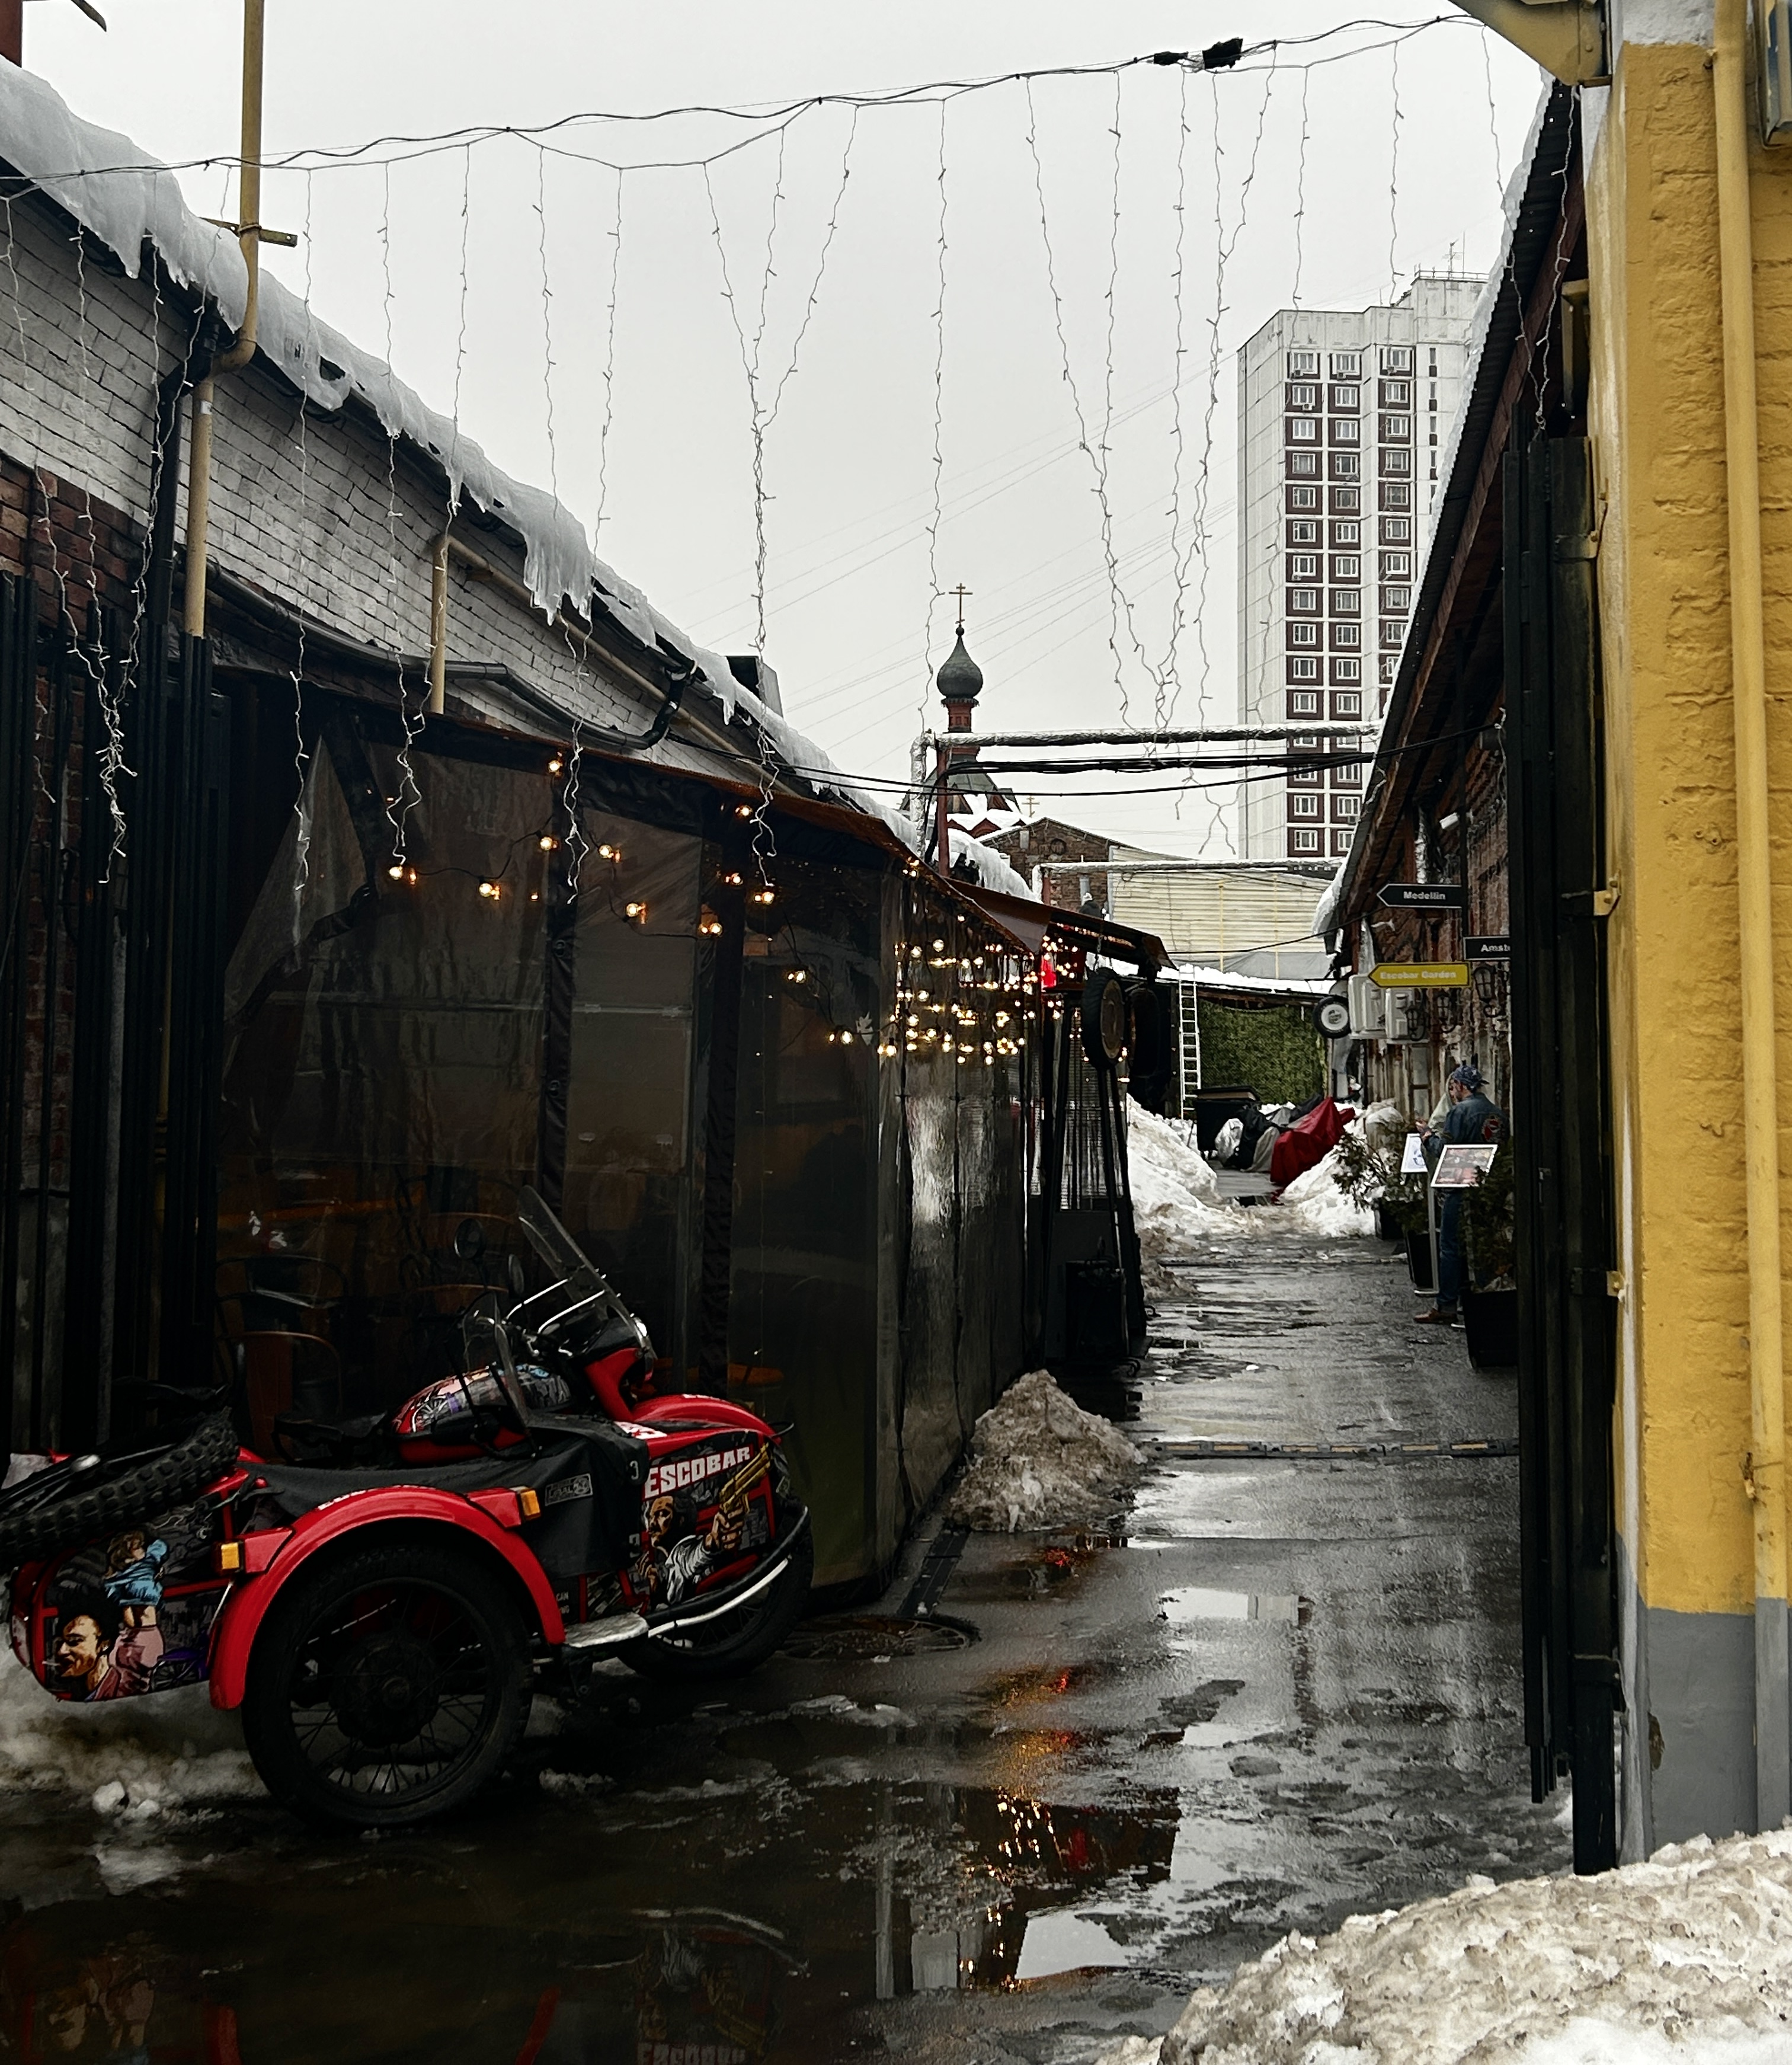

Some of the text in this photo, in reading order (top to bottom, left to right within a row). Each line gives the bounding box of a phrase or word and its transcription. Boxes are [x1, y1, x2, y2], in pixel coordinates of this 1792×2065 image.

[1403, 891, 1446, 900] Medellin
[1380, 970, 1457, 980] Escobar Garden
[645, 1446, 751, 1498] ESCOBAR
